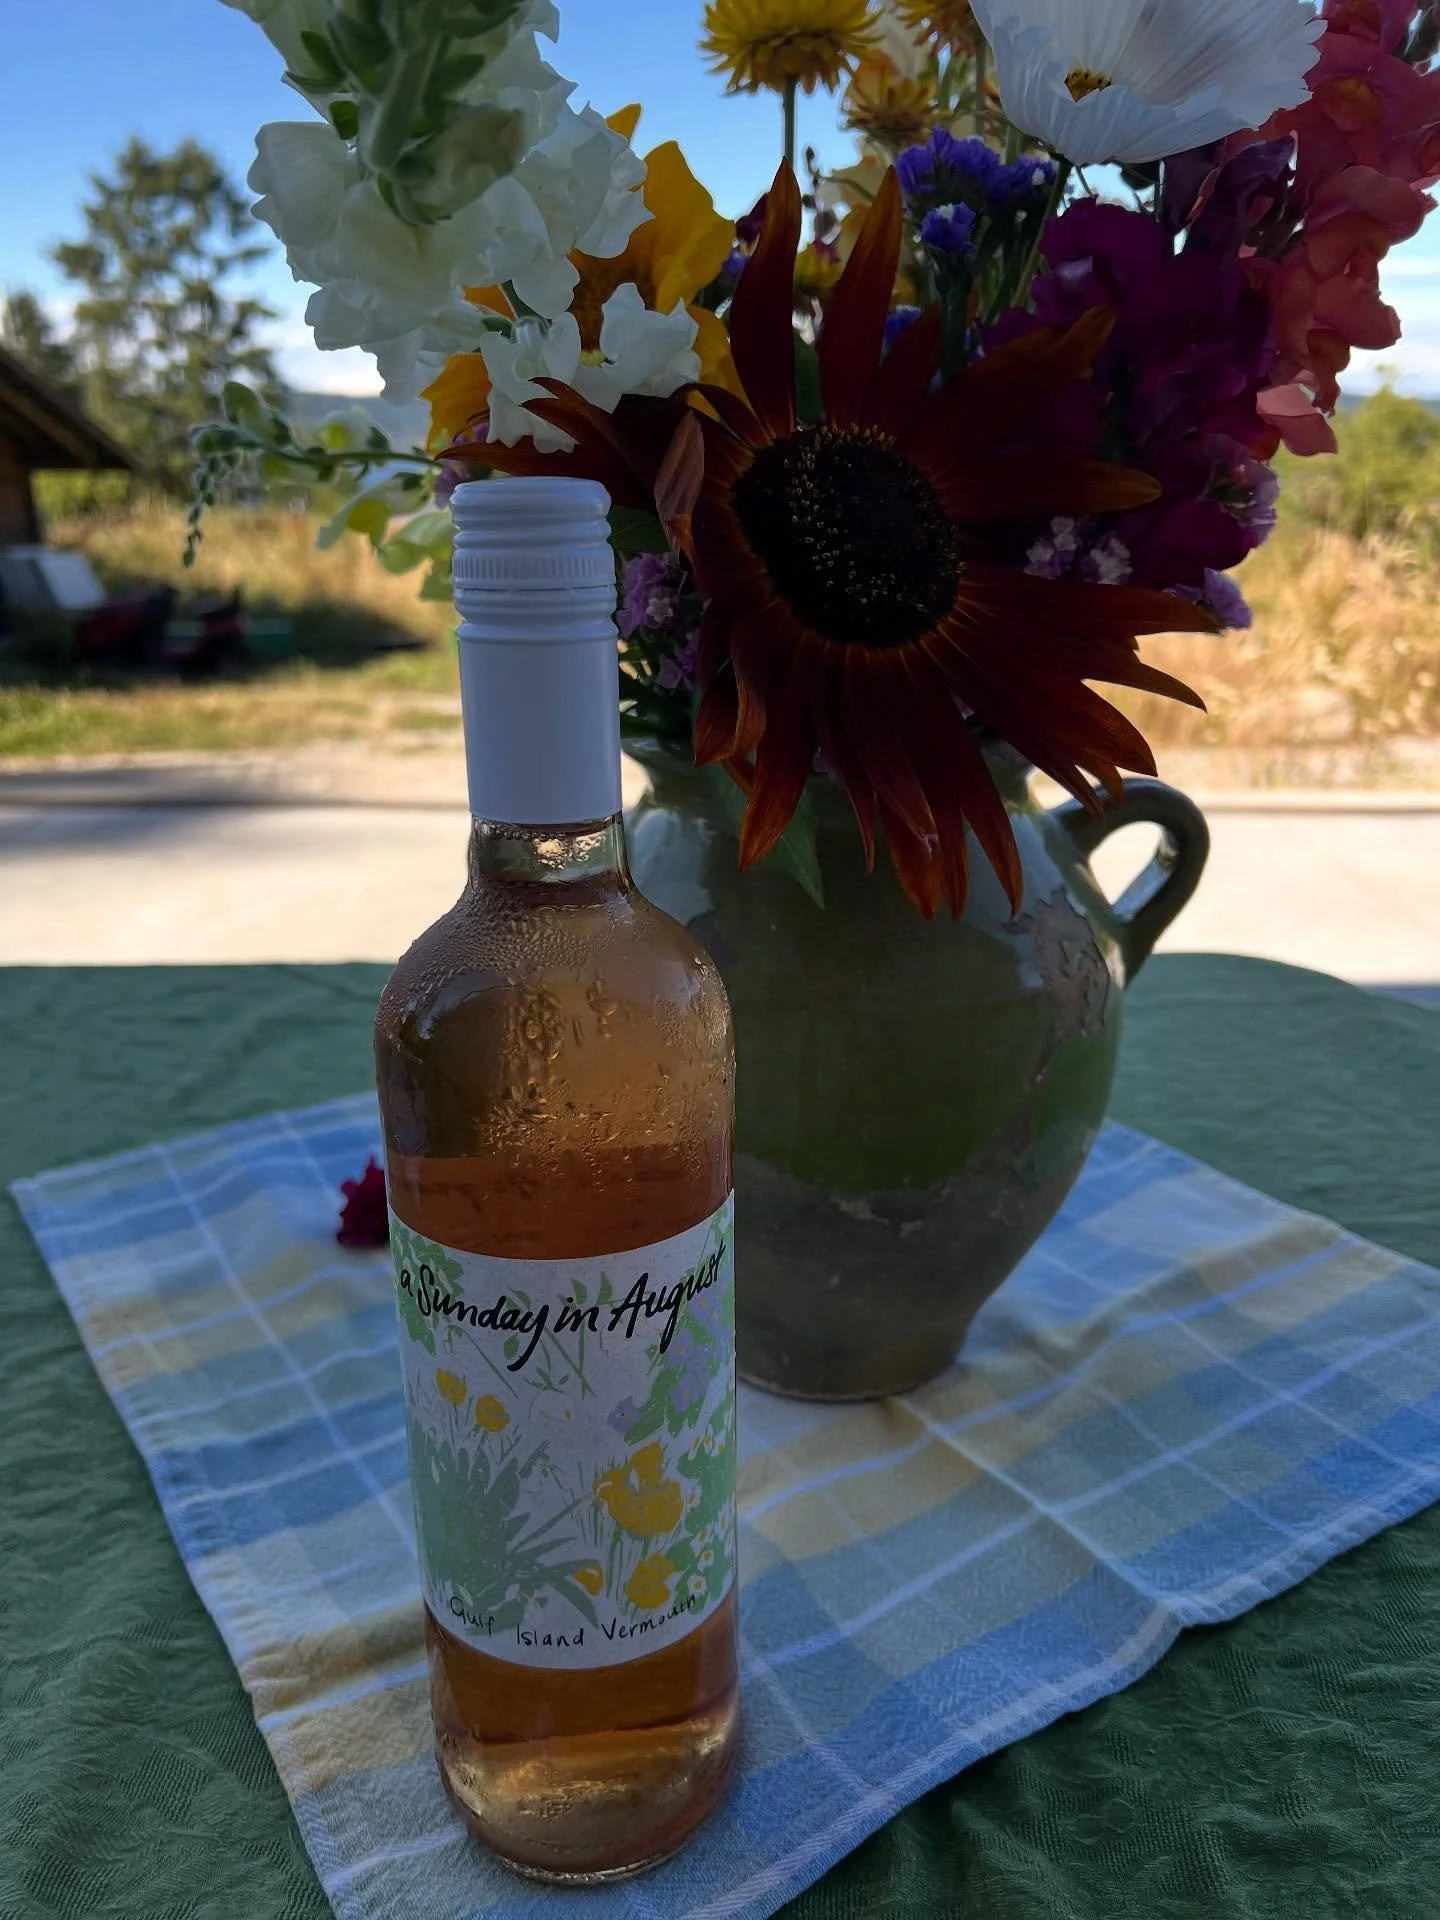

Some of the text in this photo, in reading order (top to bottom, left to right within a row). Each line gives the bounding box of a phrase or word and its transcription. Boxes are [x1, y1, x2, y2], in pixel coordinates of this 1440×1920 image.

[400, 1238, 727, 1372] a Sunday in August
[449, 1593, 698, 1648] Gulf Island Vermouth
